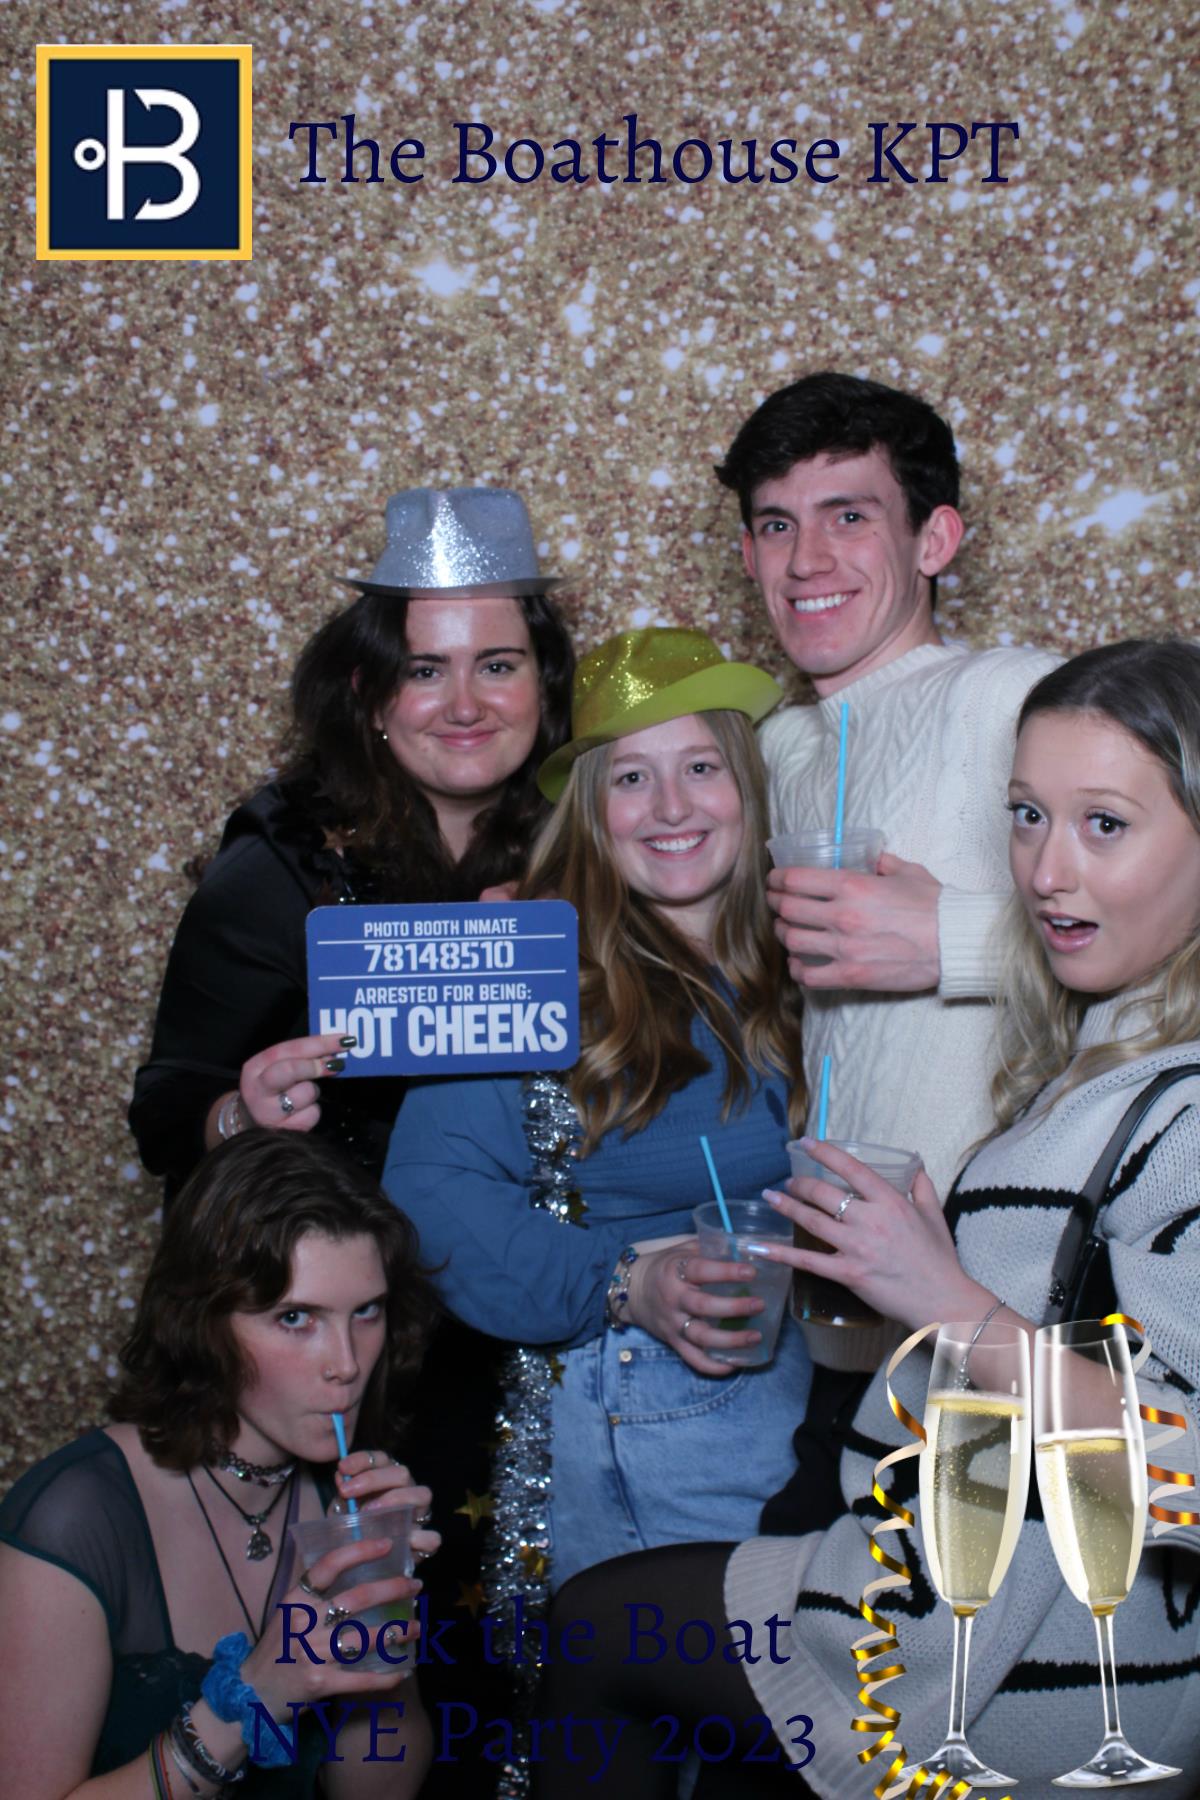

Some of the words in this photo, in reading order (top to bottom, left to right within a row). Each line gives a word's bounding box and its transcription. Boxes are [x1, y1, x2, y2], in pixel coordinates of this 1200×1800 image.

[363, 921, 409, 938] PHOTO
[414, 920, 460, 936] BOOTH
[464, 918, 518, 935] INMATE
[363, 940, 515, 973] 78148510
[354, 984, 438, 1005] ARRESTED
[443, 984, 474, 1002] FOR
[479, 983, 532, 1001] BEING:
[407, 1001, 568, 1057] CHEEKS
